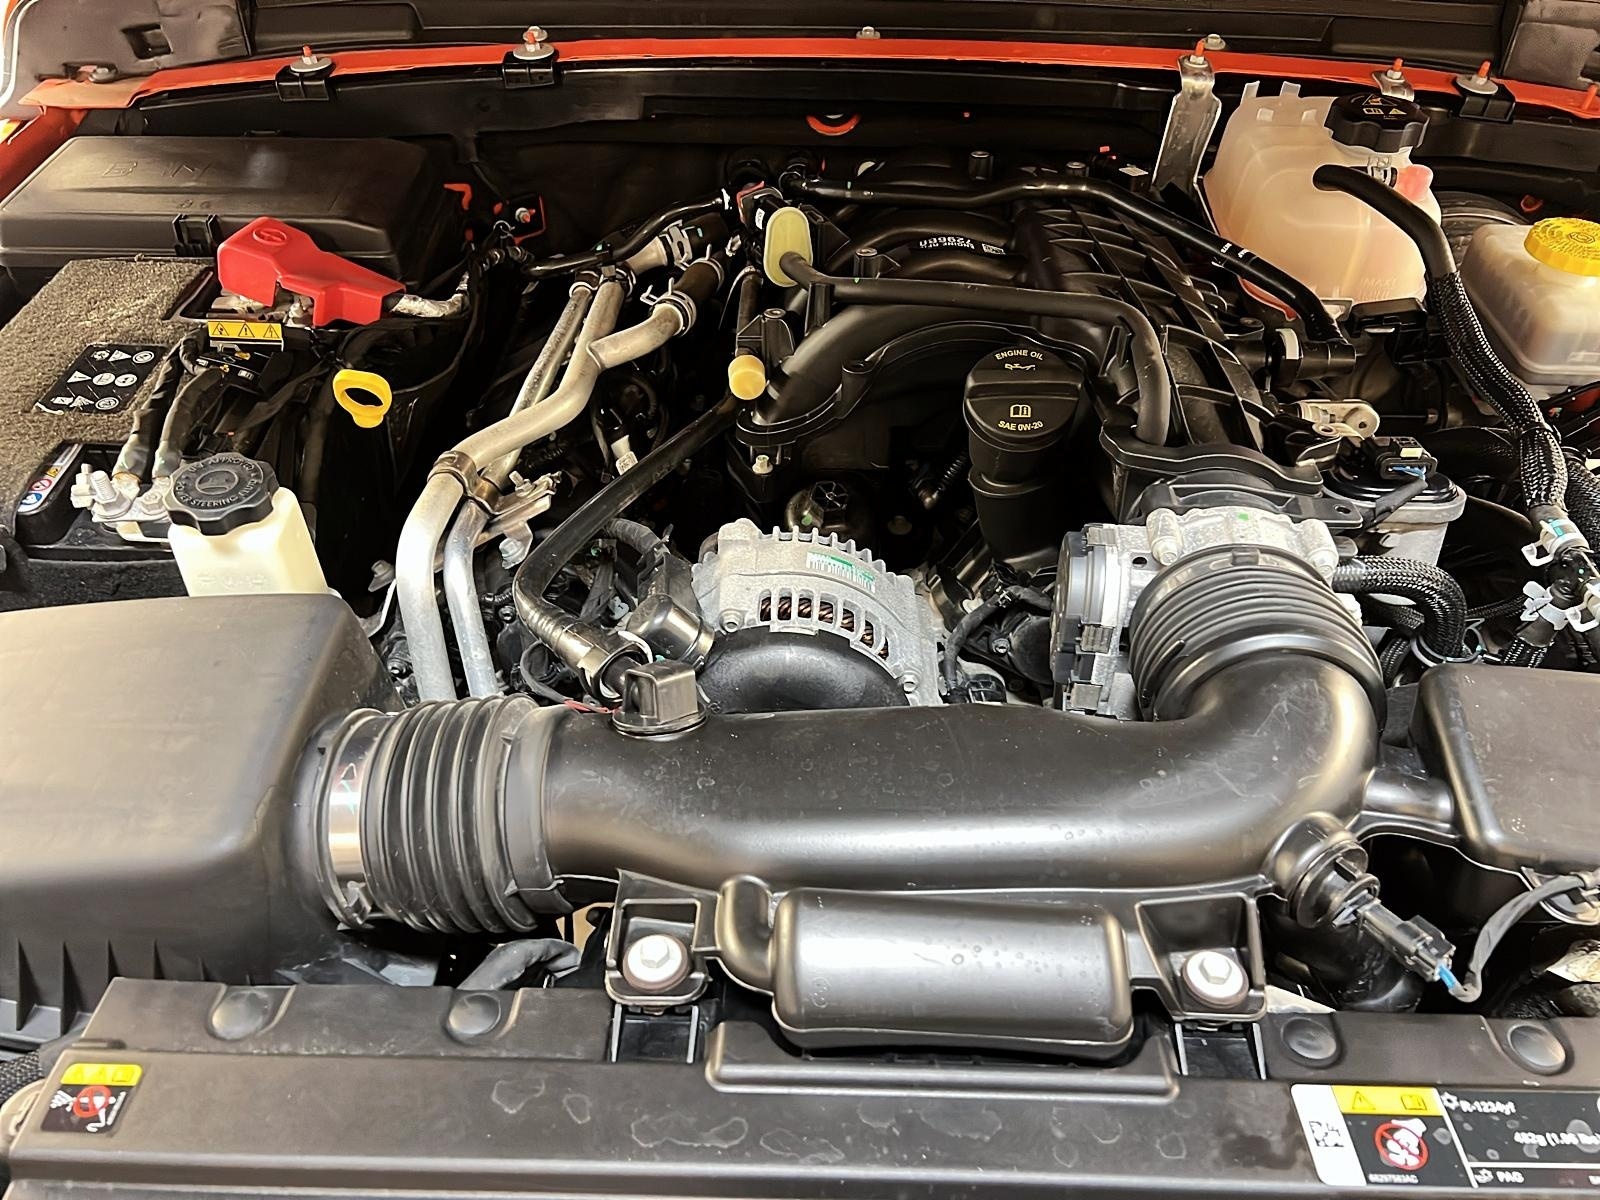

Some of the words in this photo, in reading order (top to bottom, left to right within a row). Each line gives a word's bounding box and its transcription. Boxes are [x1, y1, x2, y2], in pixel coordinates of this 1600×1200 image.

[994, 349, 1028, 360] ENGINE
[1030, 351, 1044, 361] OIL
[998, 420, 1017, 431] SAE
[1018, 420, 1044, 431] 0W-20
[190, 494, 239, 507] STEERING
